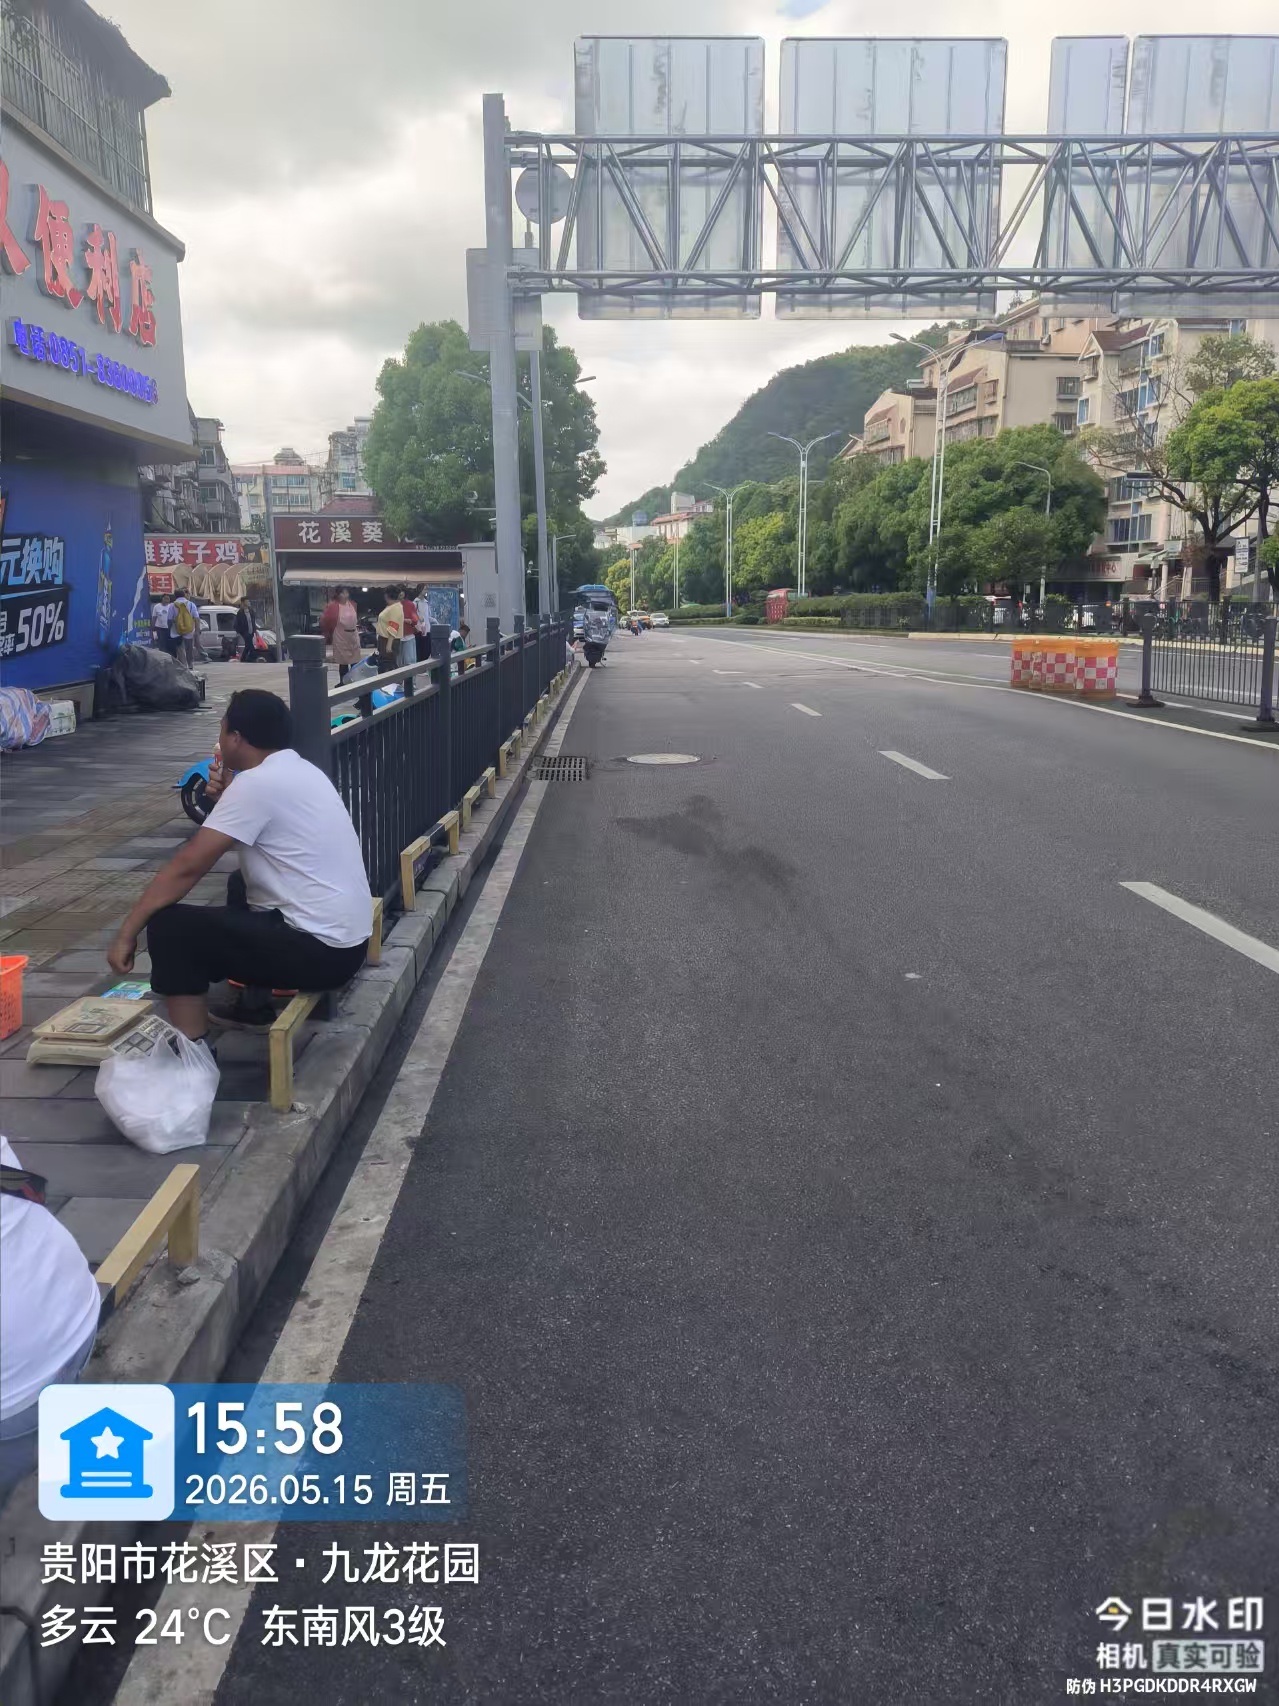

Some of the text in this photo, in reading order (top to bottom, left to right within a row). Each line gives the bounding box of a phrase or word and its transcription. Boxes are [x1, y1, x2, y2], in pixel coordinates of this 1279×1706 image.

[298, 519, 416, 544] 花溪葵
[0, 536, 64, 586] 元换购
[16, 600, 65, 652] 50%
